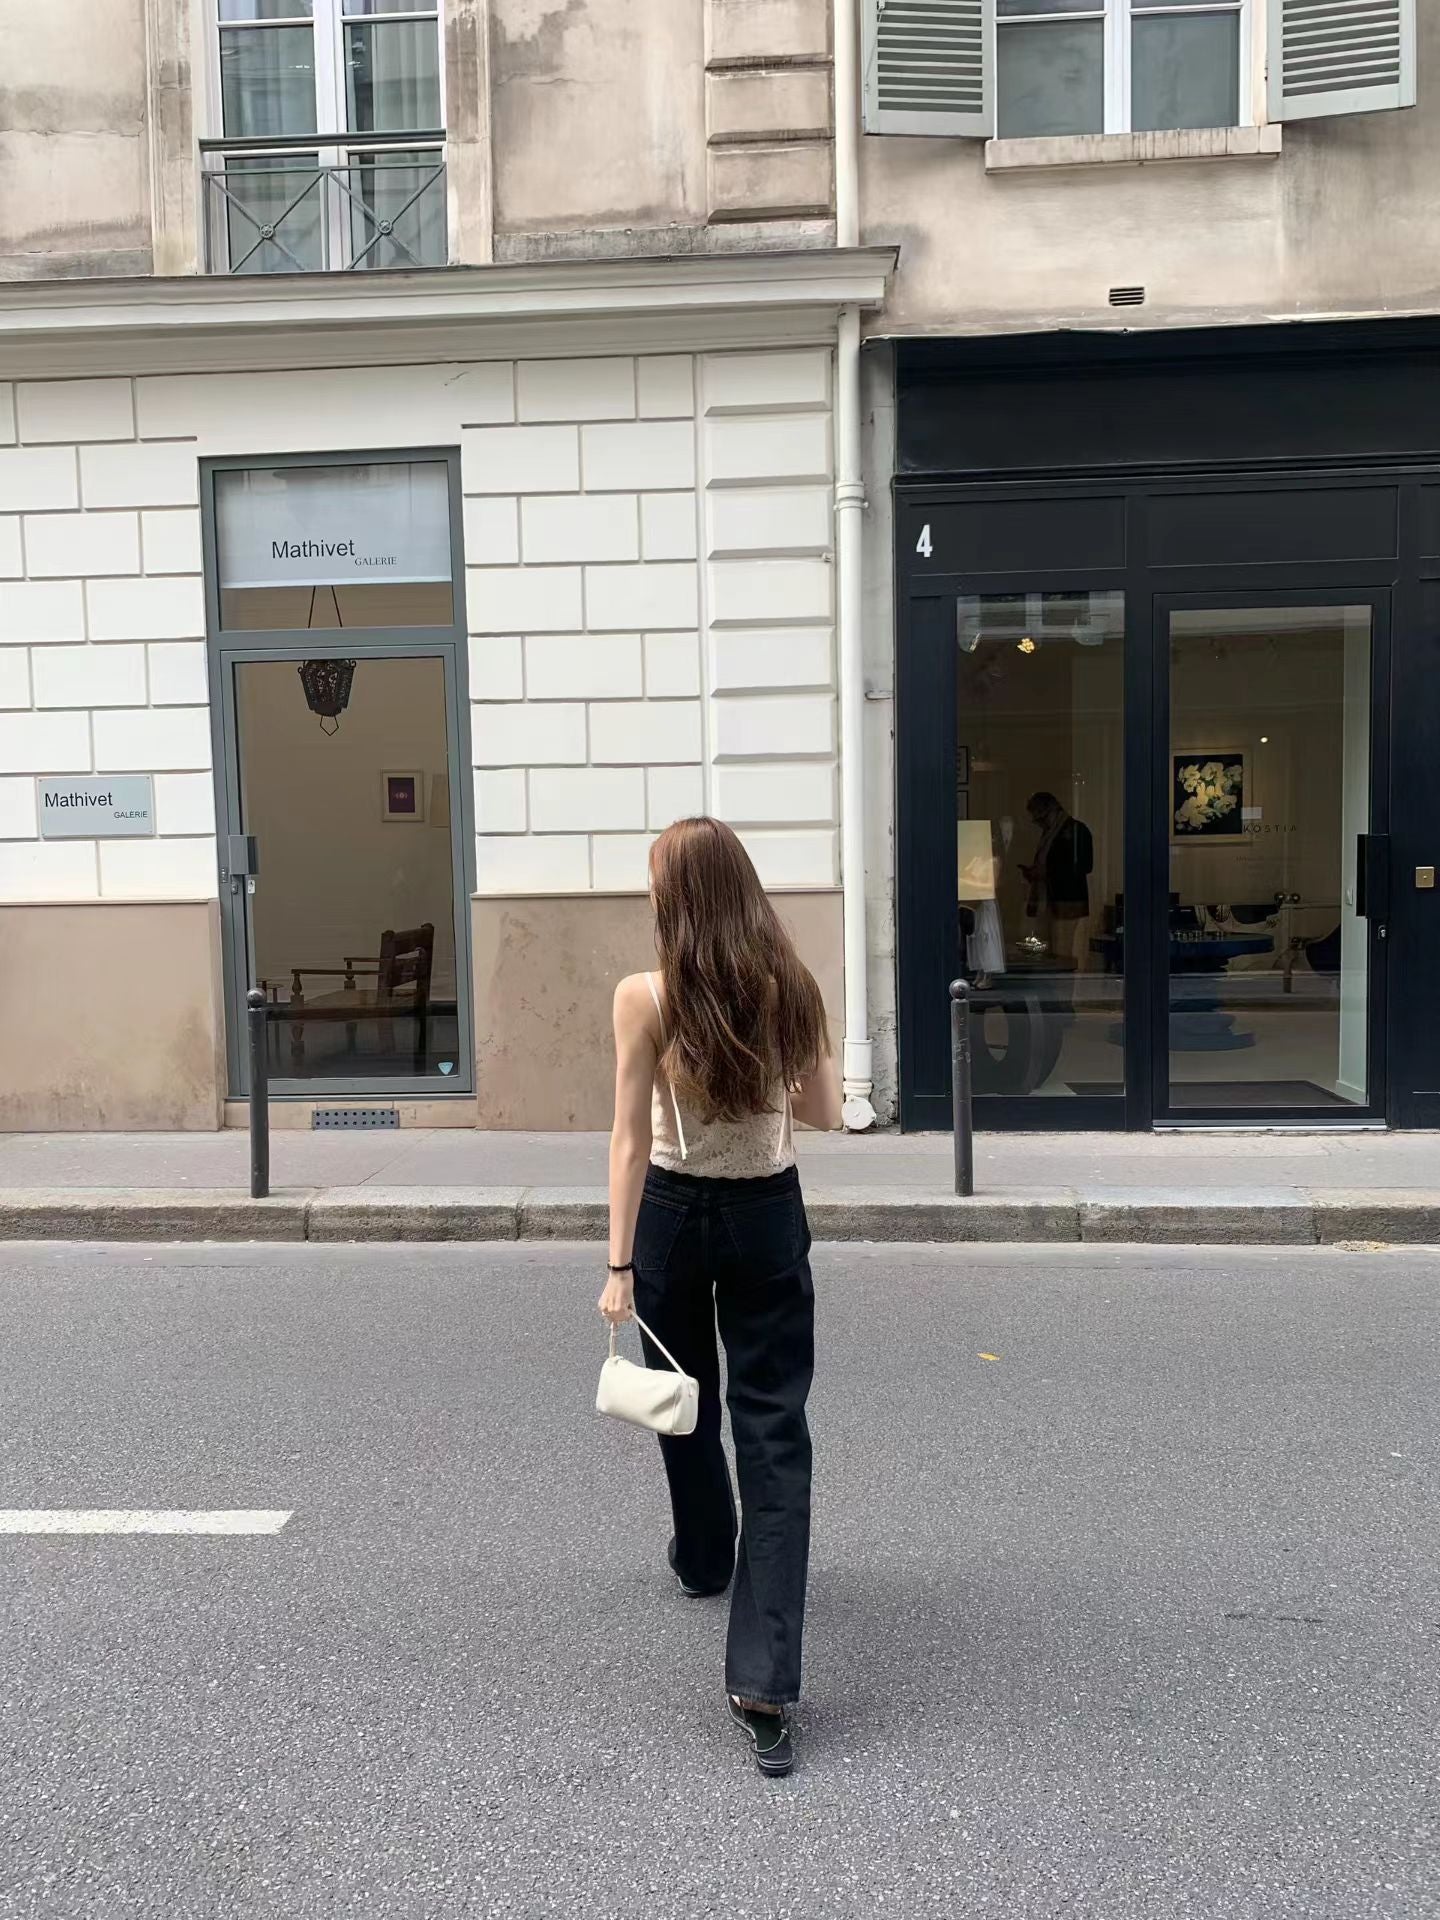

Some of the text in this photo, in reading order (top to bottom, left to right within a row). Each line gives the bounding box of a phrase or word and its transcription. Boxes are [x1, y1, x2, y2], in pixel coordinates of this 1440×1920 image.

[915, 524, 933, 558] 4
[271, 539, 355, 559] Mathivet
[354, 556, 398, 567] GALERIE
[44, 792, 113, 808] Mathivet
[113, 810, 149, 819] GALERIE
[1243, 823, 1297, 833] KOSTIA
